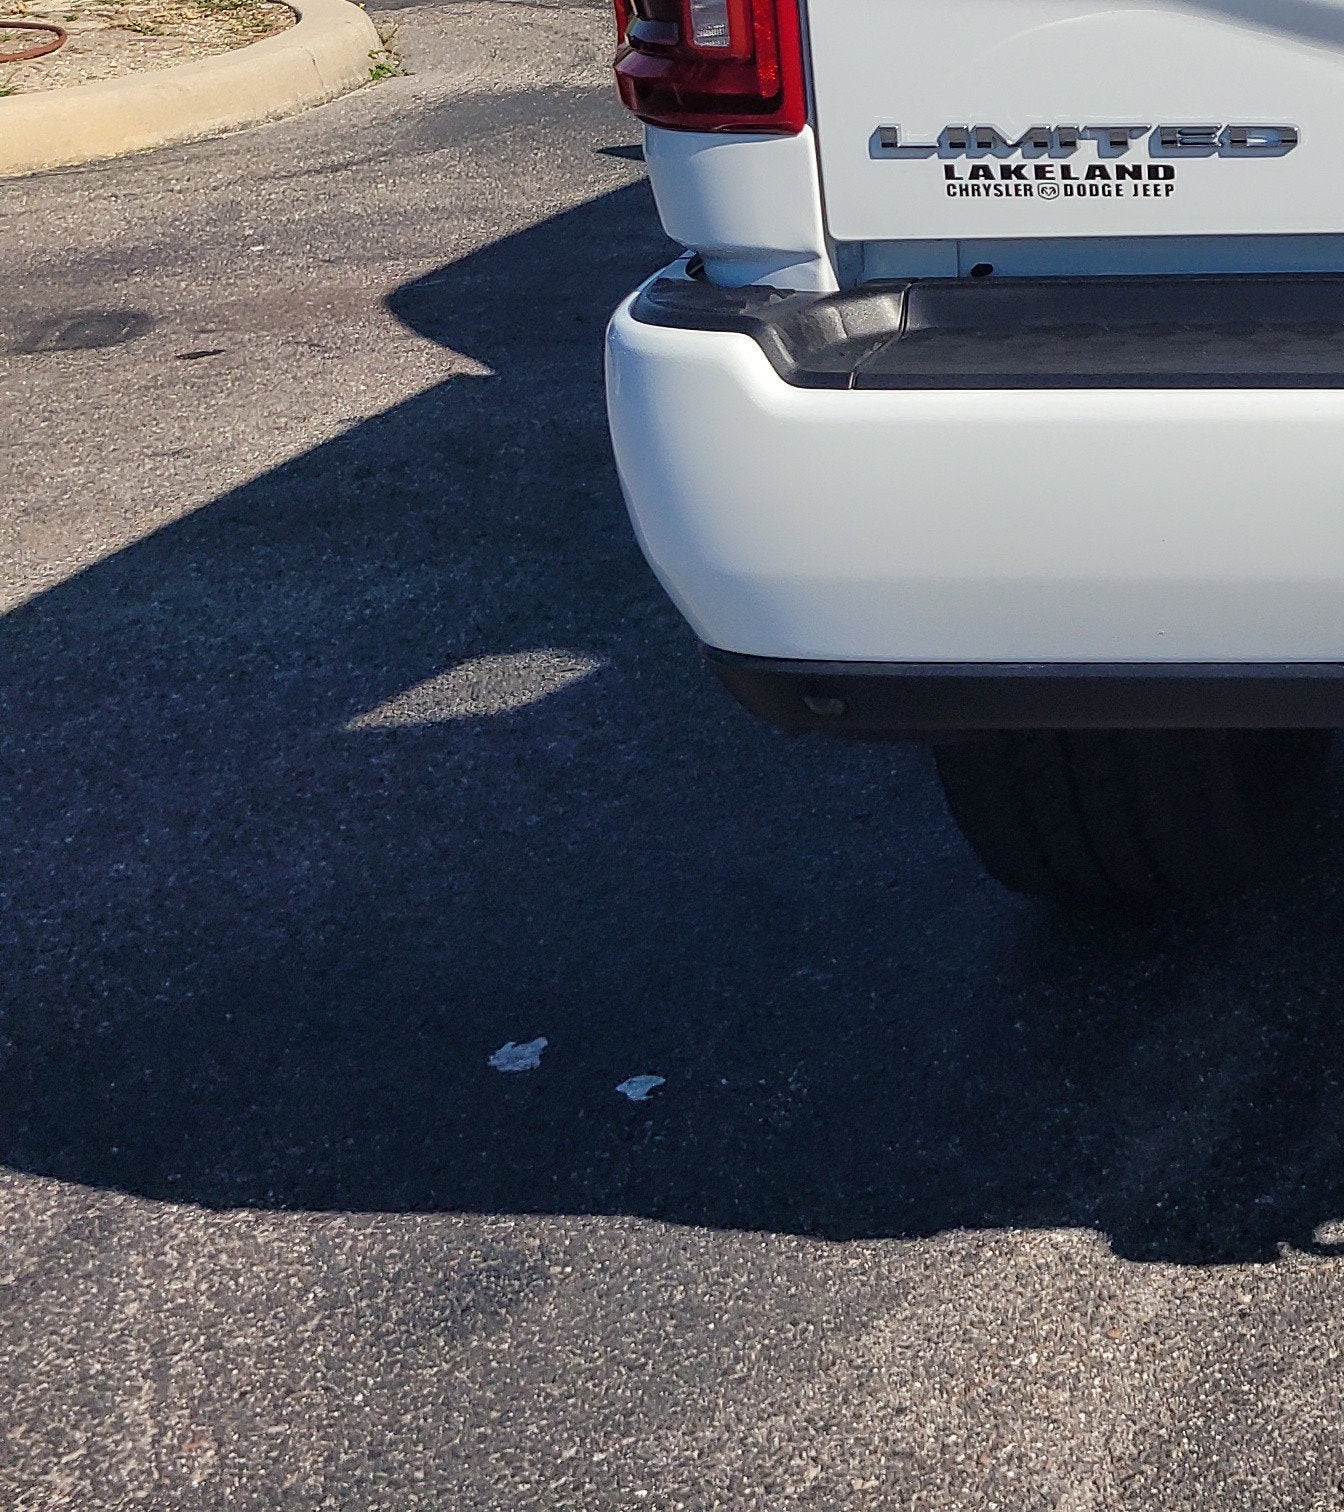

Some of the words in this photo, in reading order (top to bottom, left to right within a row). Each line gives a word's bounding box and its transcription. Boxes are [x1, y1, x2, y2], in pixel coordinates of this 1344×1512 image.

[869, 123, 1300, 159] LIMITED
[944, 164, 1176, 181] LAKELAND
[946, 183, 1034, 197] CHRYSLER
[1063, 183, 1124, 197] DODGE
[1133, 183, 1175, 197] JEEP
